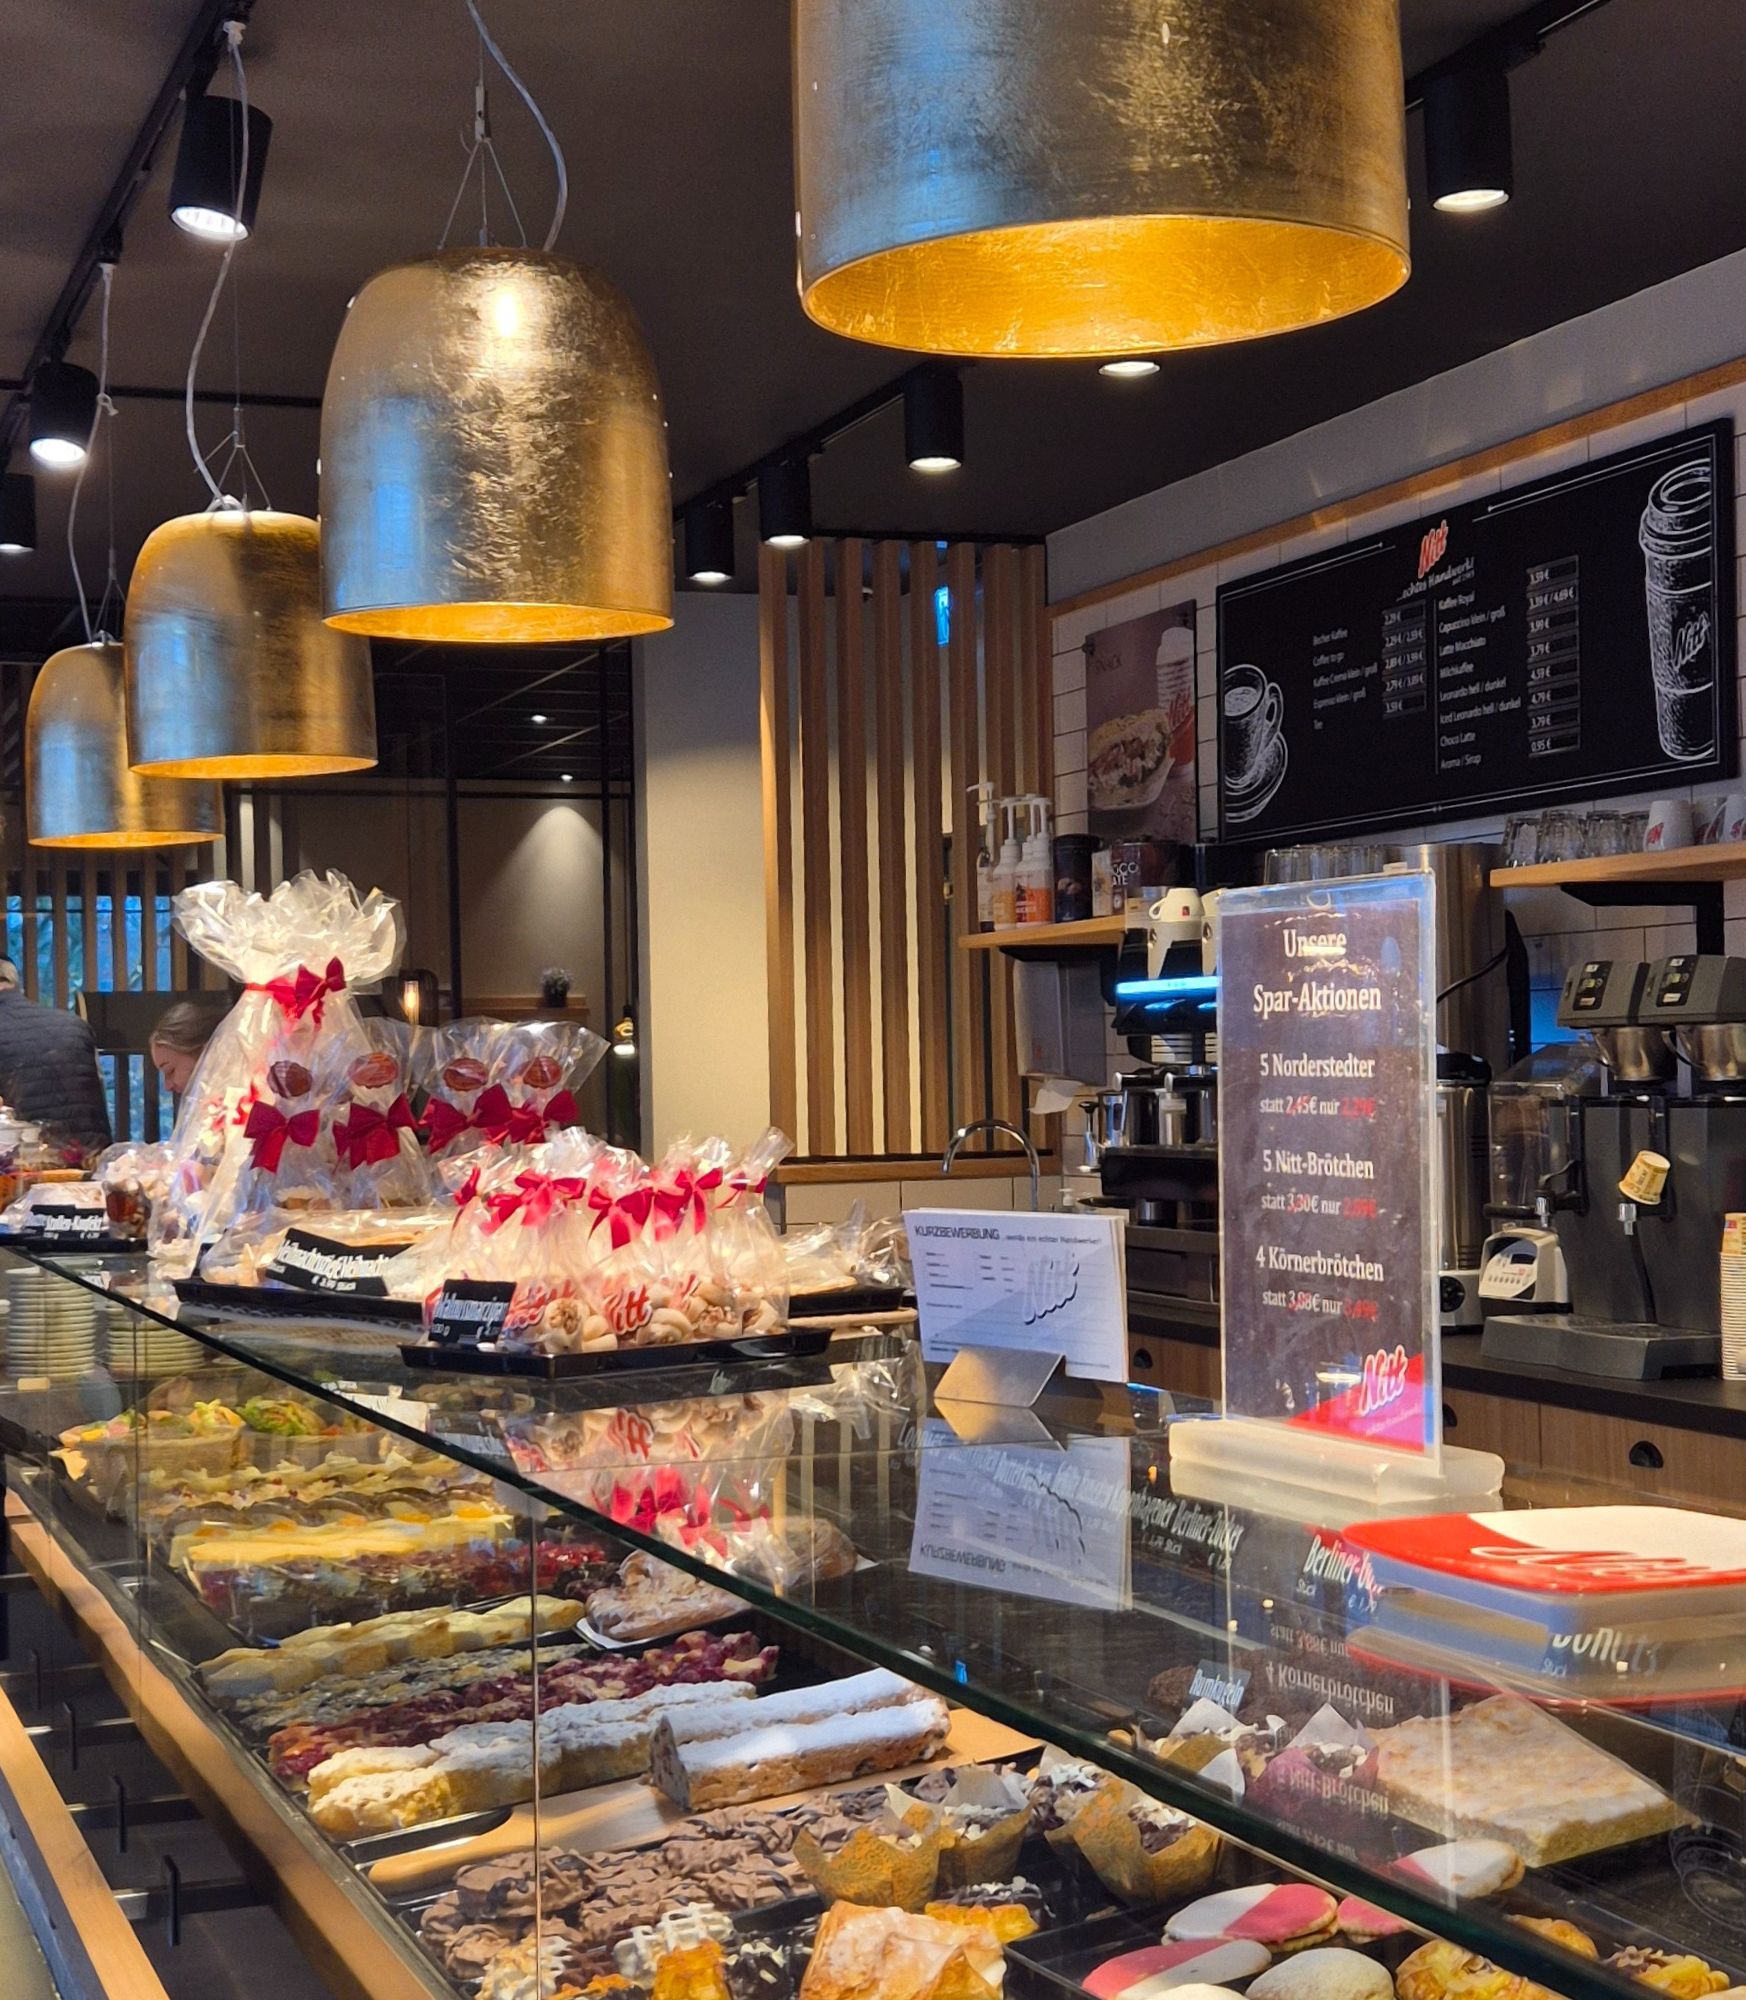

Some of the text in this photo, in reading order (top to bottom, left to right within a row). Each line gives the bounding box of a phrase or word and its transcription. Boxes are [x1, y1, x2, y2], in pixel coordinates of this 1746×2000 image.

[1417, 519, 1448, 579] Nitt
[1438, 596, 1457, 610] Kaffee
[1283, 929, 1347, 958] Unsere
[1253, 980, 1382, 1020] Spar-Aktionen
[1260, 1052, 1376, 1078] 5 Norderstedter
[1259, 1098, 1284, 1113] statt
[1320, 1101, 1340, 1115] nur
[1263, 1150, 1375, 1180] 5 Nitt-Brötchen
[1261, 1195, 1286, 1210] statt
[1321, 1200, 1342, 1215] nur
[914, 1226, 1000, 1241] KURZBEWERBUNG
[1256, 1245, 1385, 1282] 4 Körnerbrötchen
[1262, 1290, 1287, 1308] statt
[1322, 1299, 1343, 1315] nur
[1354, 1344, 1409, 1417] Nitt
